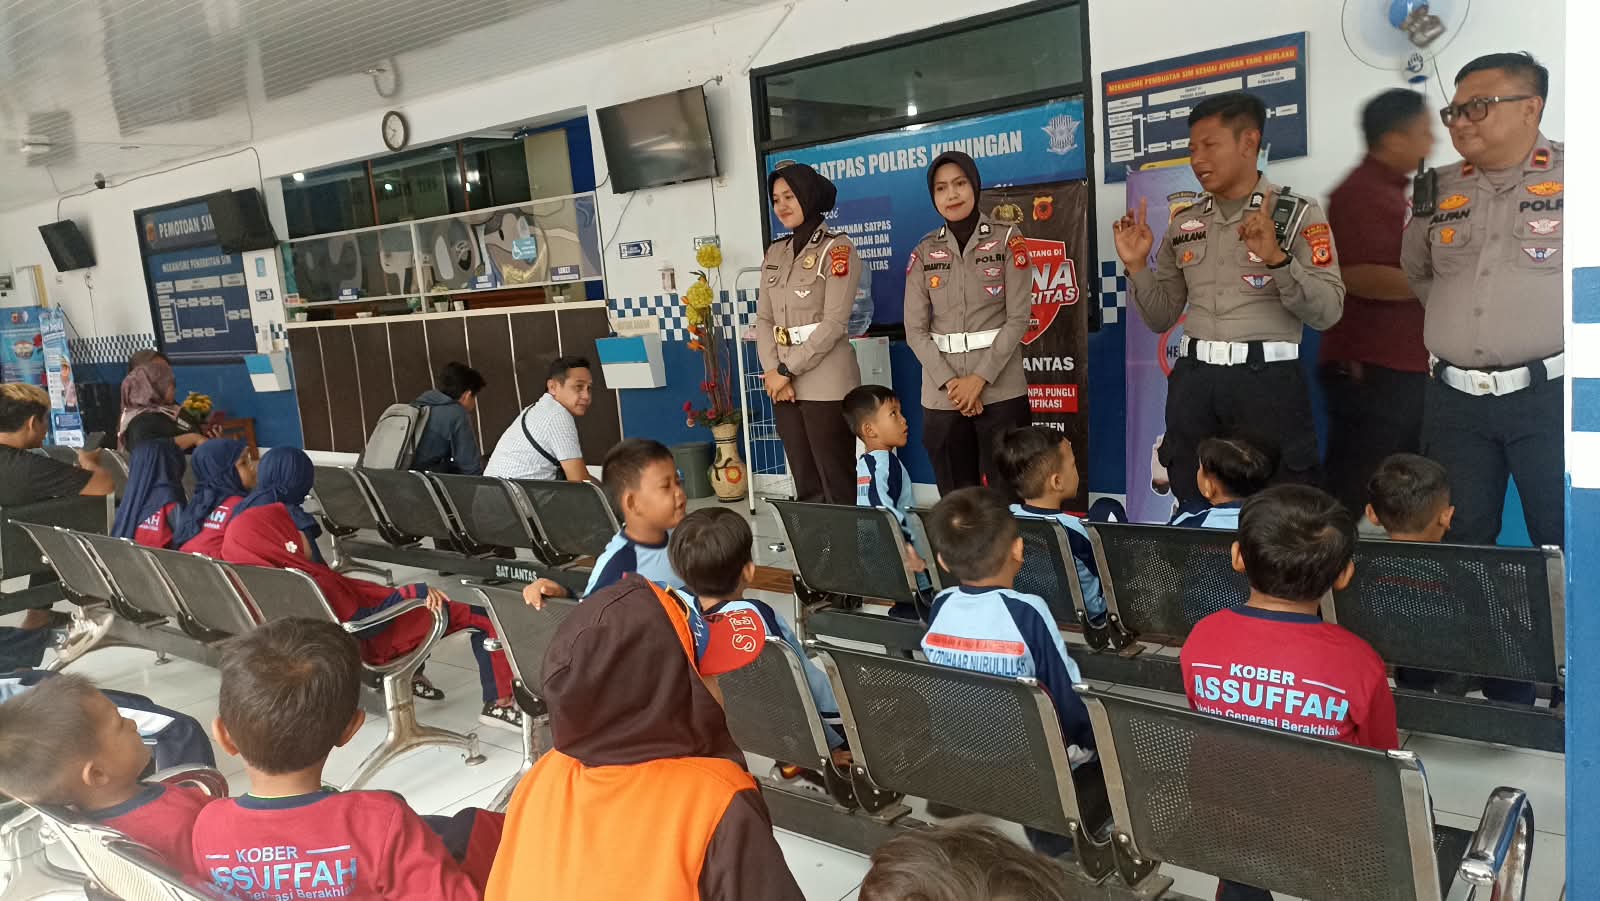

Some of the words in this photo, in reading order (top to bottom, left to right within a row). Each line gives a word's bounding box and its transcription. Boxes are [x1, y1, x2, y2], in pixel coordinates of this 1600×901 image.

[1145, 73, 1181, 86] PEMBUATAN
[1182, 68, 1194, 79] SIM
[868, 151, 927, 175] POLRES
[159, 217, 200, 238] PEMOTOAN
[864, 220, 892, 232] SATPAS
[874, 233, 889, 245] DAN
[975, 253, 1005, 265] POLRI
[1053, 248, 1062, 256] DI
[1045, 387, 1076, 397] PUNGLI
[495, 564, 509, 578] SAT
[510, 567, 538, 582] LANTAS
[1229, 663, 1295, 686] KOBER
[1194, 674, 1349, 721] ASSUFFAH
[1225, 708, 1278, 728] Generasi
[236, 845, 298, 863] KOBER
[210, 857, 357, 892] SSUFFAH
